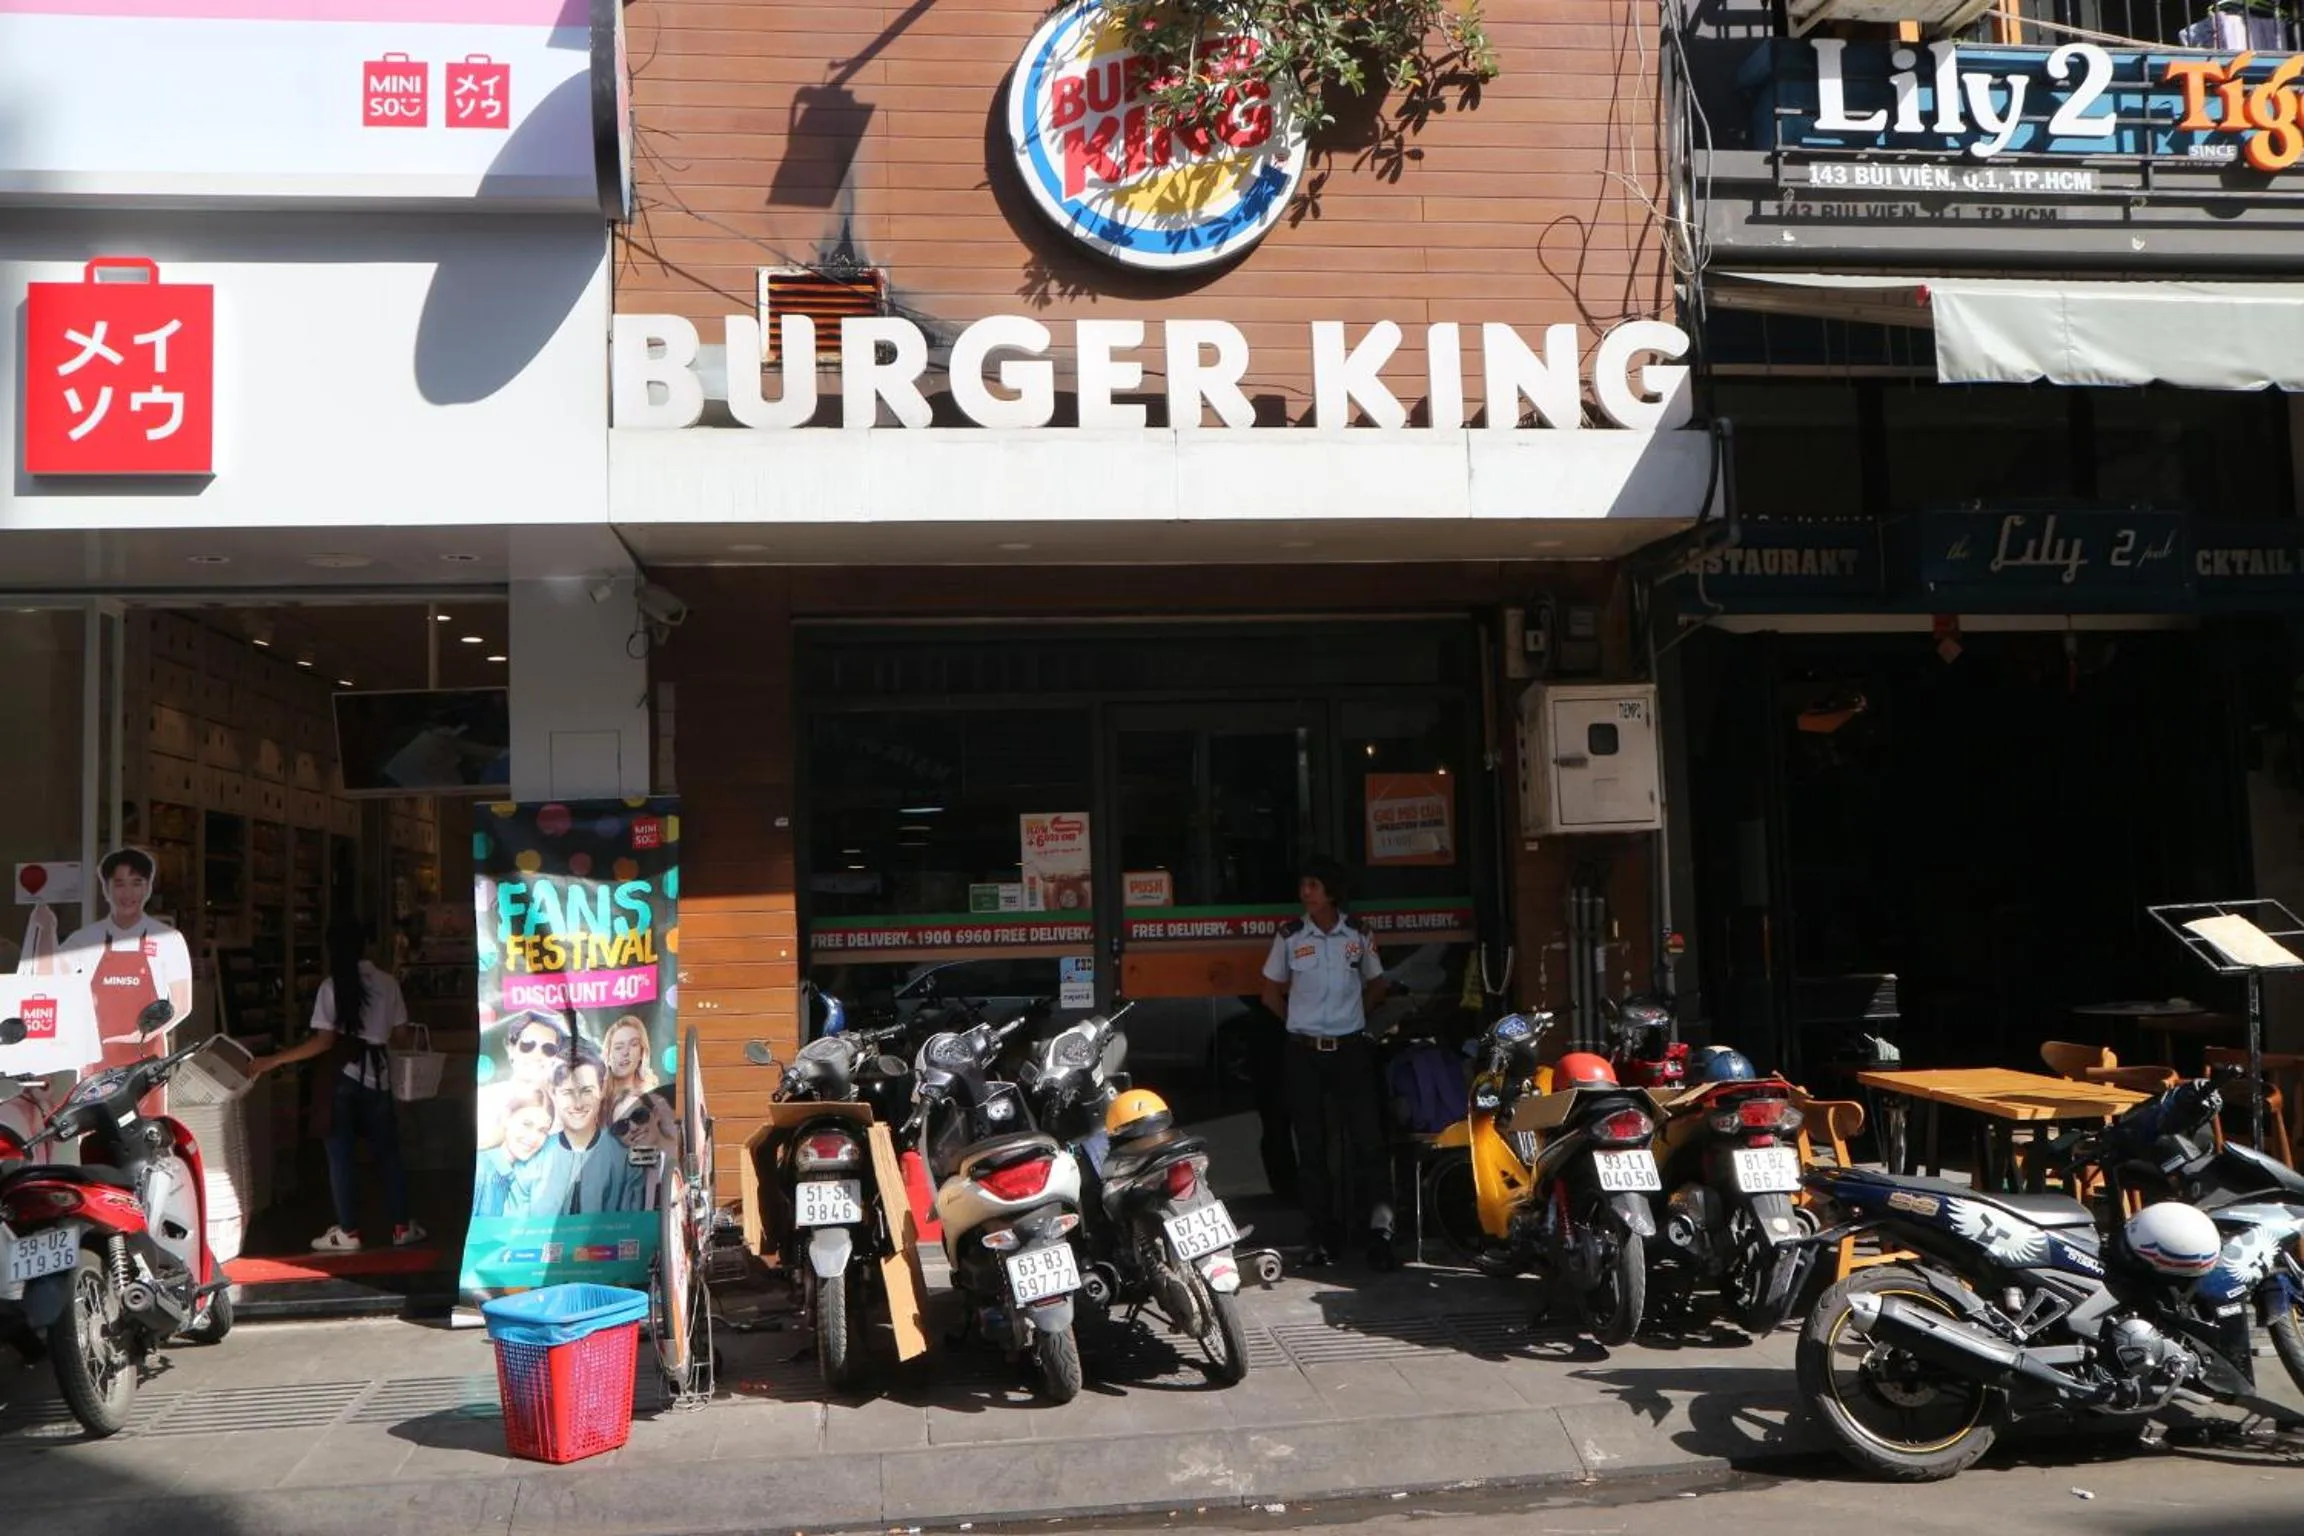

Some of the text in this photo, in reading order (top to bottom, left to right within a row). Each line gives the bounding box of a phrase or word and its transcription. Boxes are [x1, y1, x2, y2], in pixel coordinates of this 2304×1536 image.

[369, 75, 422, 94] MINI
[1809, 38, 2117, 157] Lily 2
[2189, 145, 2237, 158] SINCE
[1809, 165, 1848, 186] 143
[1855, 162, 1892, 186] BÙI
[2011, 170, 2093, 191] TP.HCM
[57, 319, 183, 376] メイ
[612, 314, 1693, 430] BURGER KING
[63, 385, 185, 442] ソウ
[1989, 514, 2089, 584] Lily
[2109, 529, 2136, 566] 2
[1129, 879, 1164, 894] PUSH
[497, 879, 652, 942] FANS
[811, 933, 844, 948] FREE
[917, 930, 952, 945] 1900
[955, 929, 992, 944] 6960
[994, 928, 1028, 943] FREE
[1132, 921, 1165, 938] FREE
[1240, 920, 1276, 935] 1900
[506, 928, 658, 973] FESTIVAL
[103, 976, 140, 986] MINISO
[511, 972, 650, 1005] DISCOUNT 40%
[24, 1007, 53, 1019] MINI
[1604, 1150, 1645, 1170] 93-L1
[807, 1202, 852, 1221] 9846
[1175, 1206, 1221, 1236] 67-L2
[19, 1230, 68, 1259] 59-U2
[12, 1248, 74, 1280] 119.36
[1018, 1248, 1063, 1277] 63-B3
[1017, 1265, 1076, 1300] 697.72
